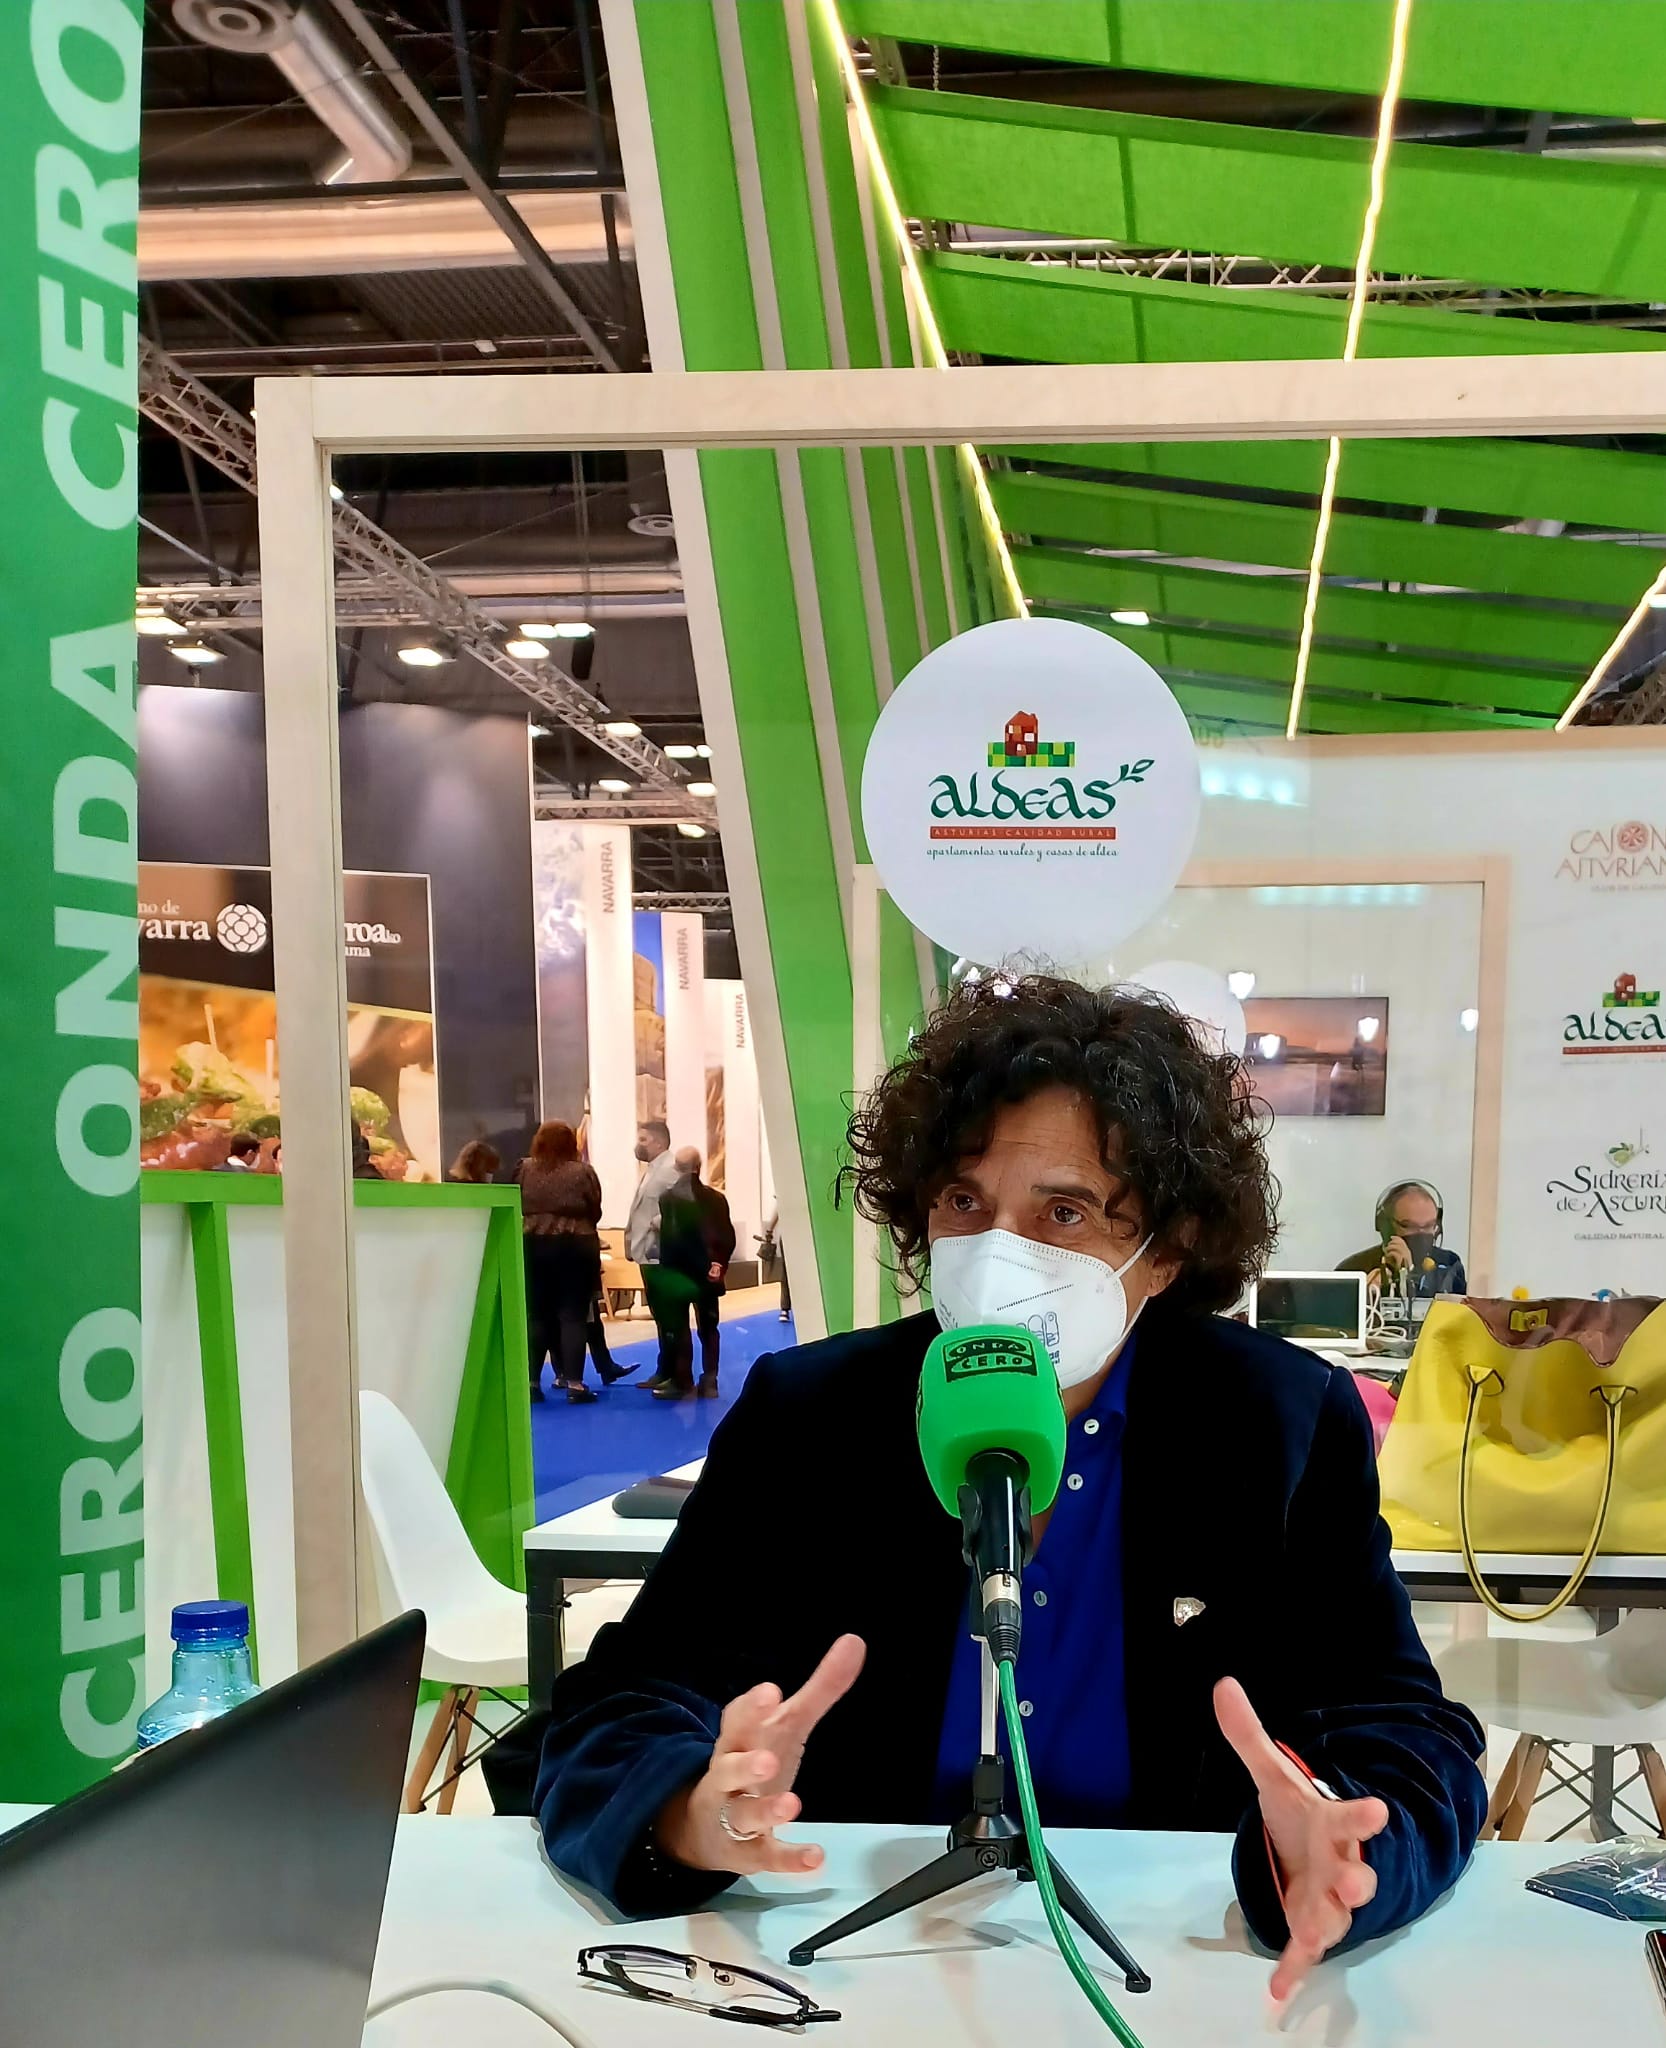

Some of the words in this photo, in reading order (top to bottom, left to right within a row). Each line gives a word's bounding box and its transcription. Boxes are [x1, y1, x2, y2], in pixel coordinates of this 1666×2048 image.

[30, 0, 144, 530] CERO
[926, 845, 995, 861] apartamentos
[998, 842, 1034, 857] rurales
[1036, 848, 1043, 863] y
[1046, 849, 1073, 857] casas
[1075, 844, 1088, 857] de
[1089, 842, 1118, 857] aldea
[933, 827, 998, 838] ASTURIAS
[1004, 827, 1063, 838] CALIDAD
[1071, 827, 1112, 838] RURAL
[601, 841, 615, 914] NAVARRA
[50, 619, 140, 1197] ONDA
[676, 927, 690, 990] NAVARRA
[735, 993, 746, 1049] NAVARRA
[955, 1342, 1020, 1354] ONDA
[961, 1354, 1023, 1369] CERO
[59, 1307, 145, 1758] CERO
